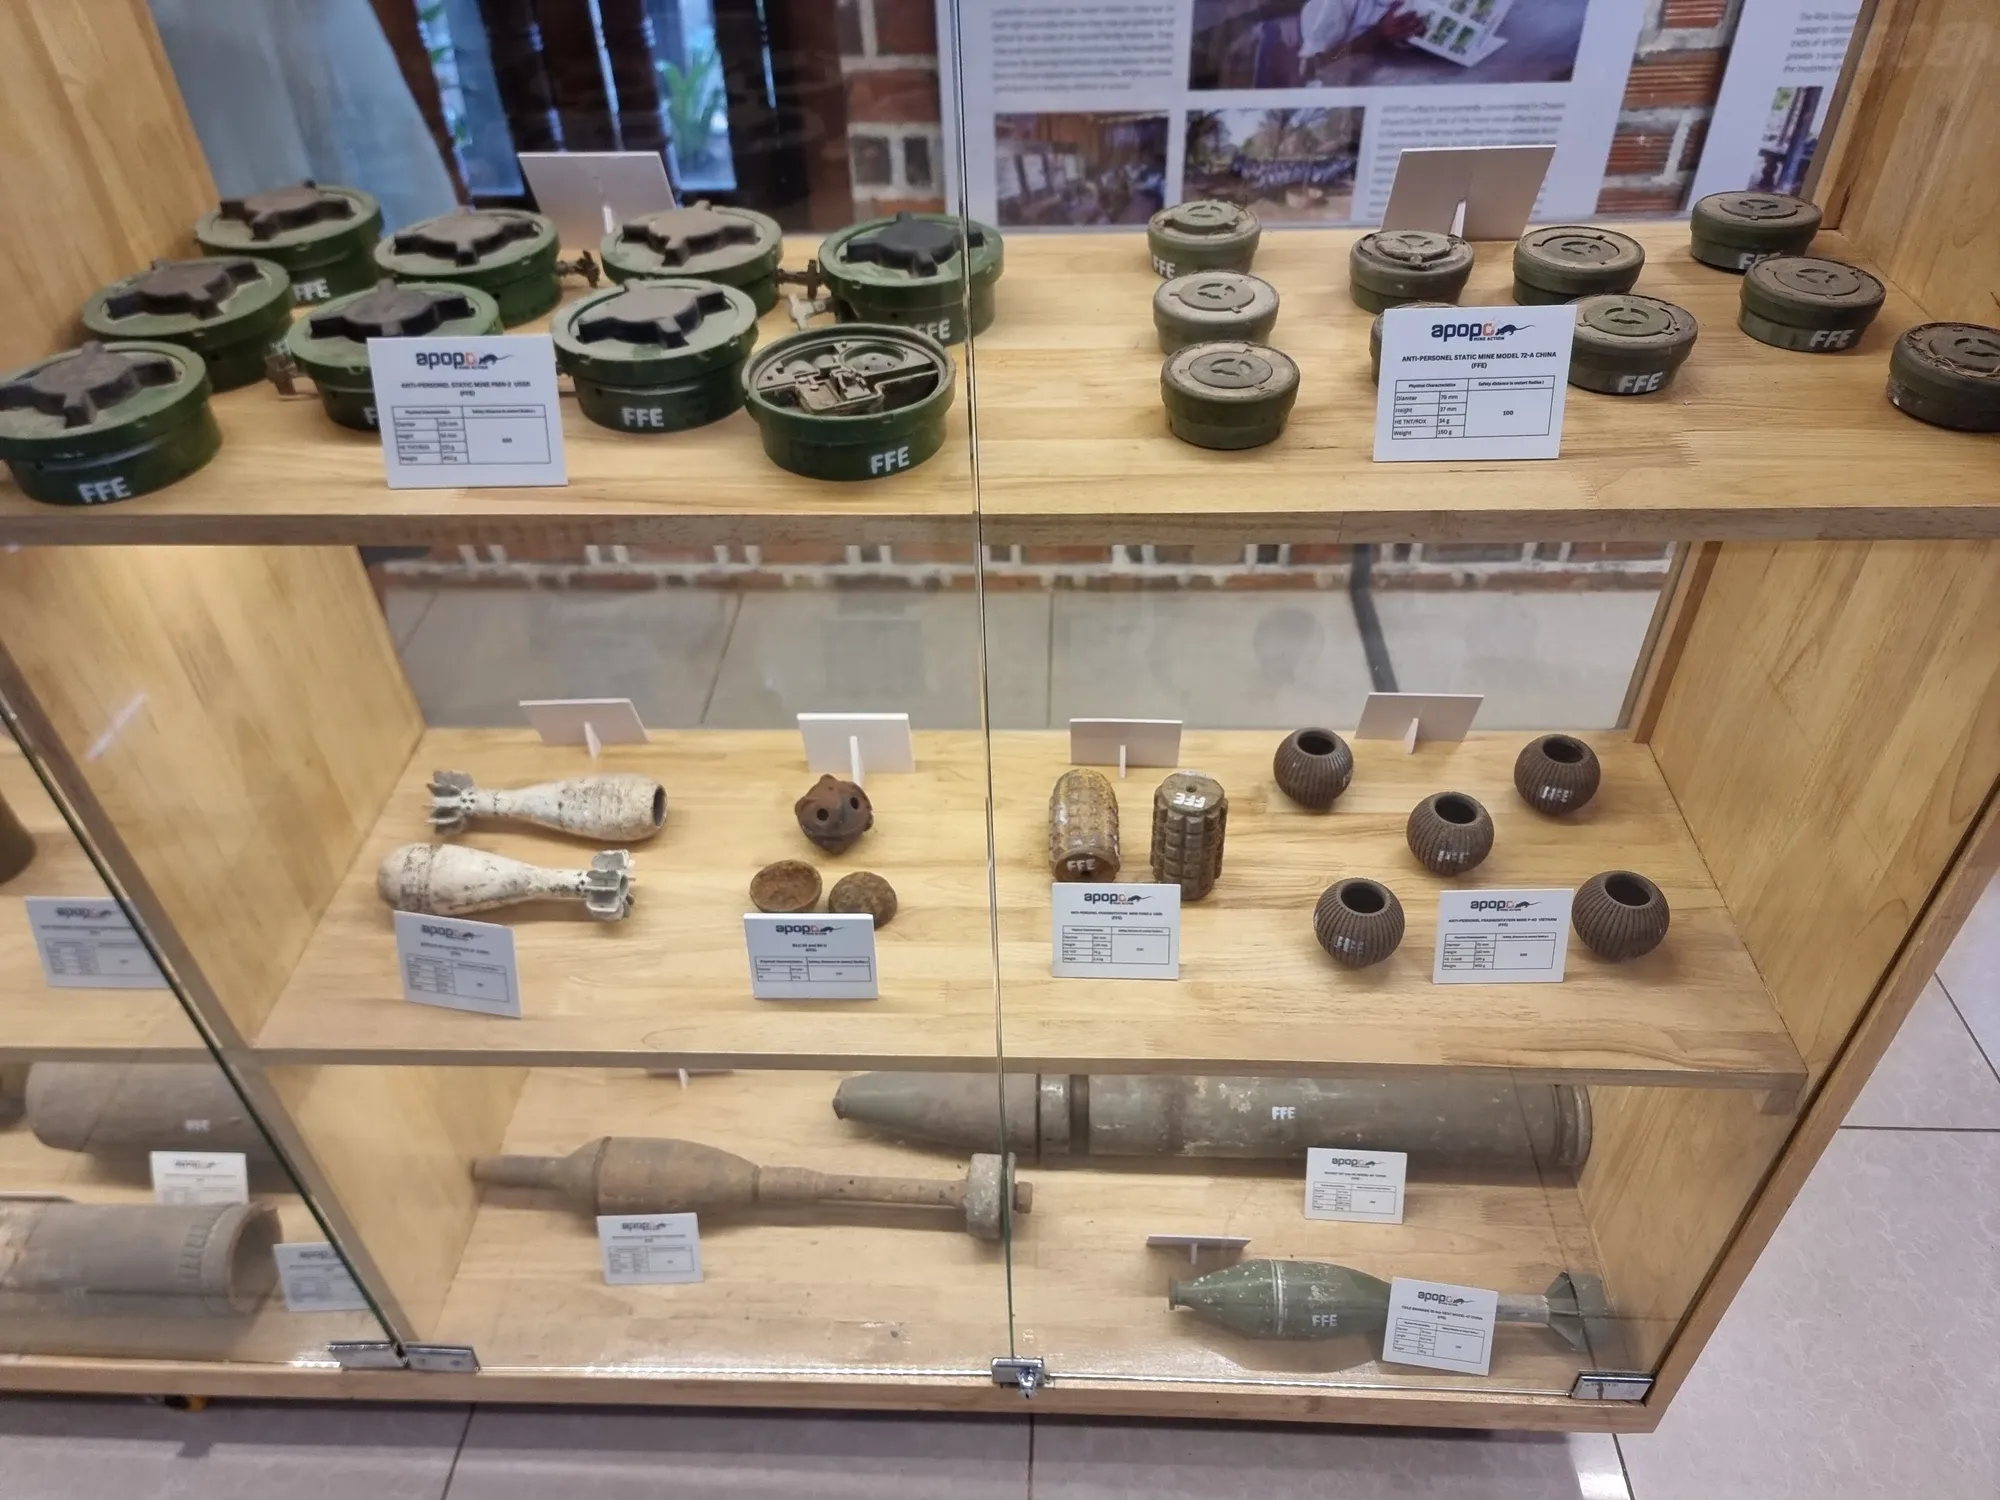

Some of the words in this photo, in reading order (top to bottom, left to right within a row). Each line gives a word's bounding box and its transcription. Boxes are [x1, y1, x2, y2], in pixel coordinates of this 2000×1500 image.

[1152, 255, 1175, 279] FFE
[292, 278, 331, 300] FFE
[1809, 329, 1854, 347] FFE
[1618, 371, 1663, 393] FFE
[621, 407, 664, 428] FFE
[871, 446, 909, 474] FFE
[78, 476, 131, 504] FFE
[1173, 792, 1206, 808] FFE
[1067, 859, 1096, 872] FFE
[1271, 1106, 1296, 1120] FFE
[1311, 1314, 1338, 1327] FFE
